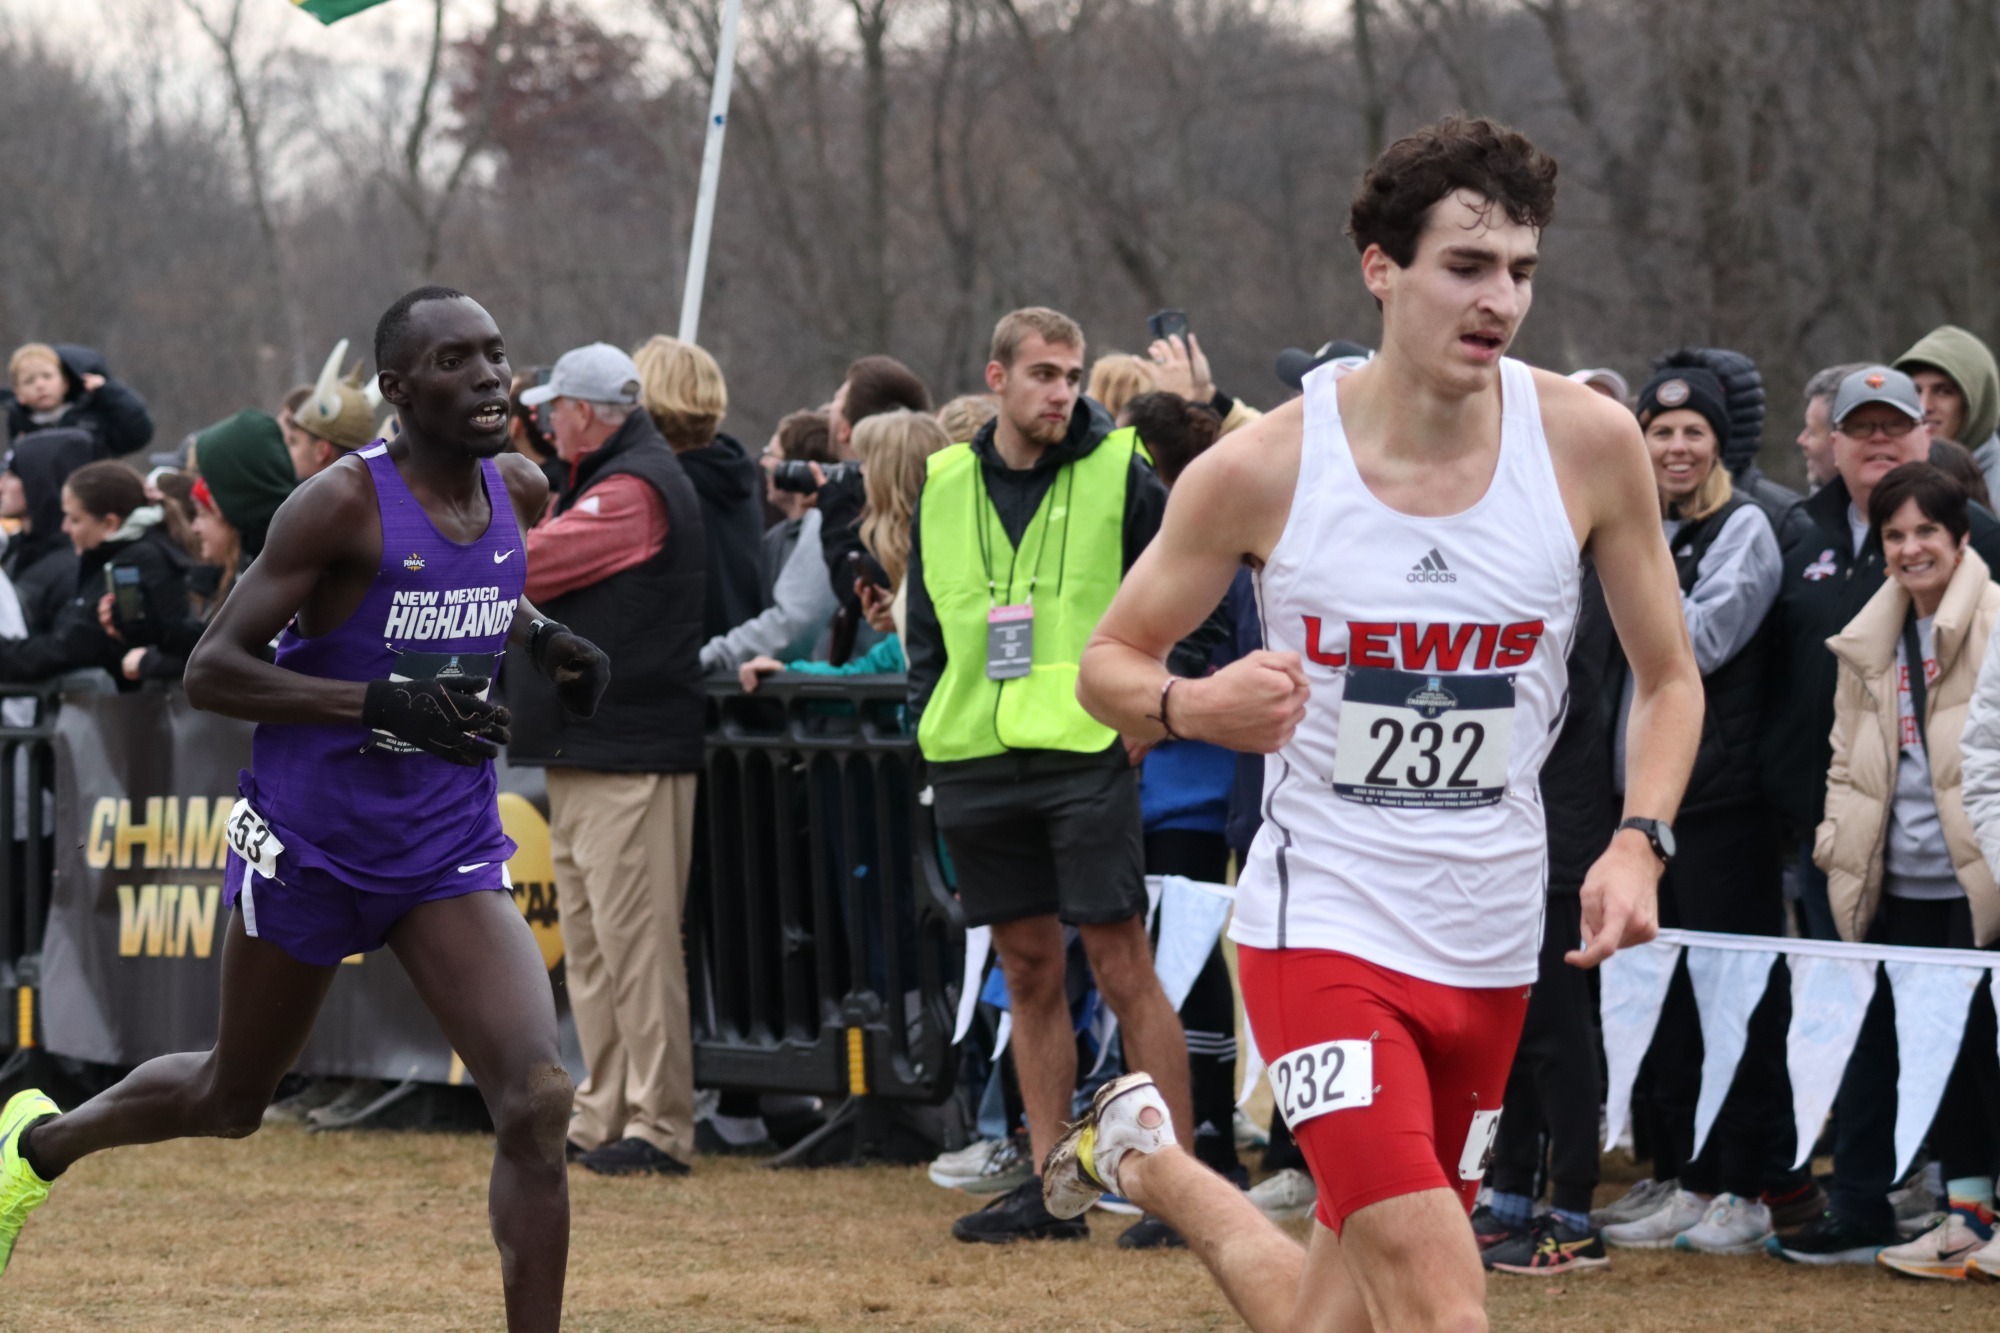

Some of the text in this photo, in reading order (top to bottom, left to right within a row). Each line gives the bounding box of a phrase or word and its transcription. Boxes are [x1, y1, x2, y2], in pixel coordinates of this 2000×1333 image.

[403, 559, 425, 568] RMAC
[1406, 569, 1457, 583] adidas
[383, 598, 518, 640] HIGHLANDS
[392, 586, 499, 606] NEW MEXICO
[1300, 614, 1545, 671] LEWIS
[1406, 698, 1456, 707] CHAMPIONSHIPS
[1364, 717, 1485, 788] 232
[84, 796, 236, 870] CHAM
[117, 884, 220, 958] WIN
[1278, 1046, 1345, 1120] 232
